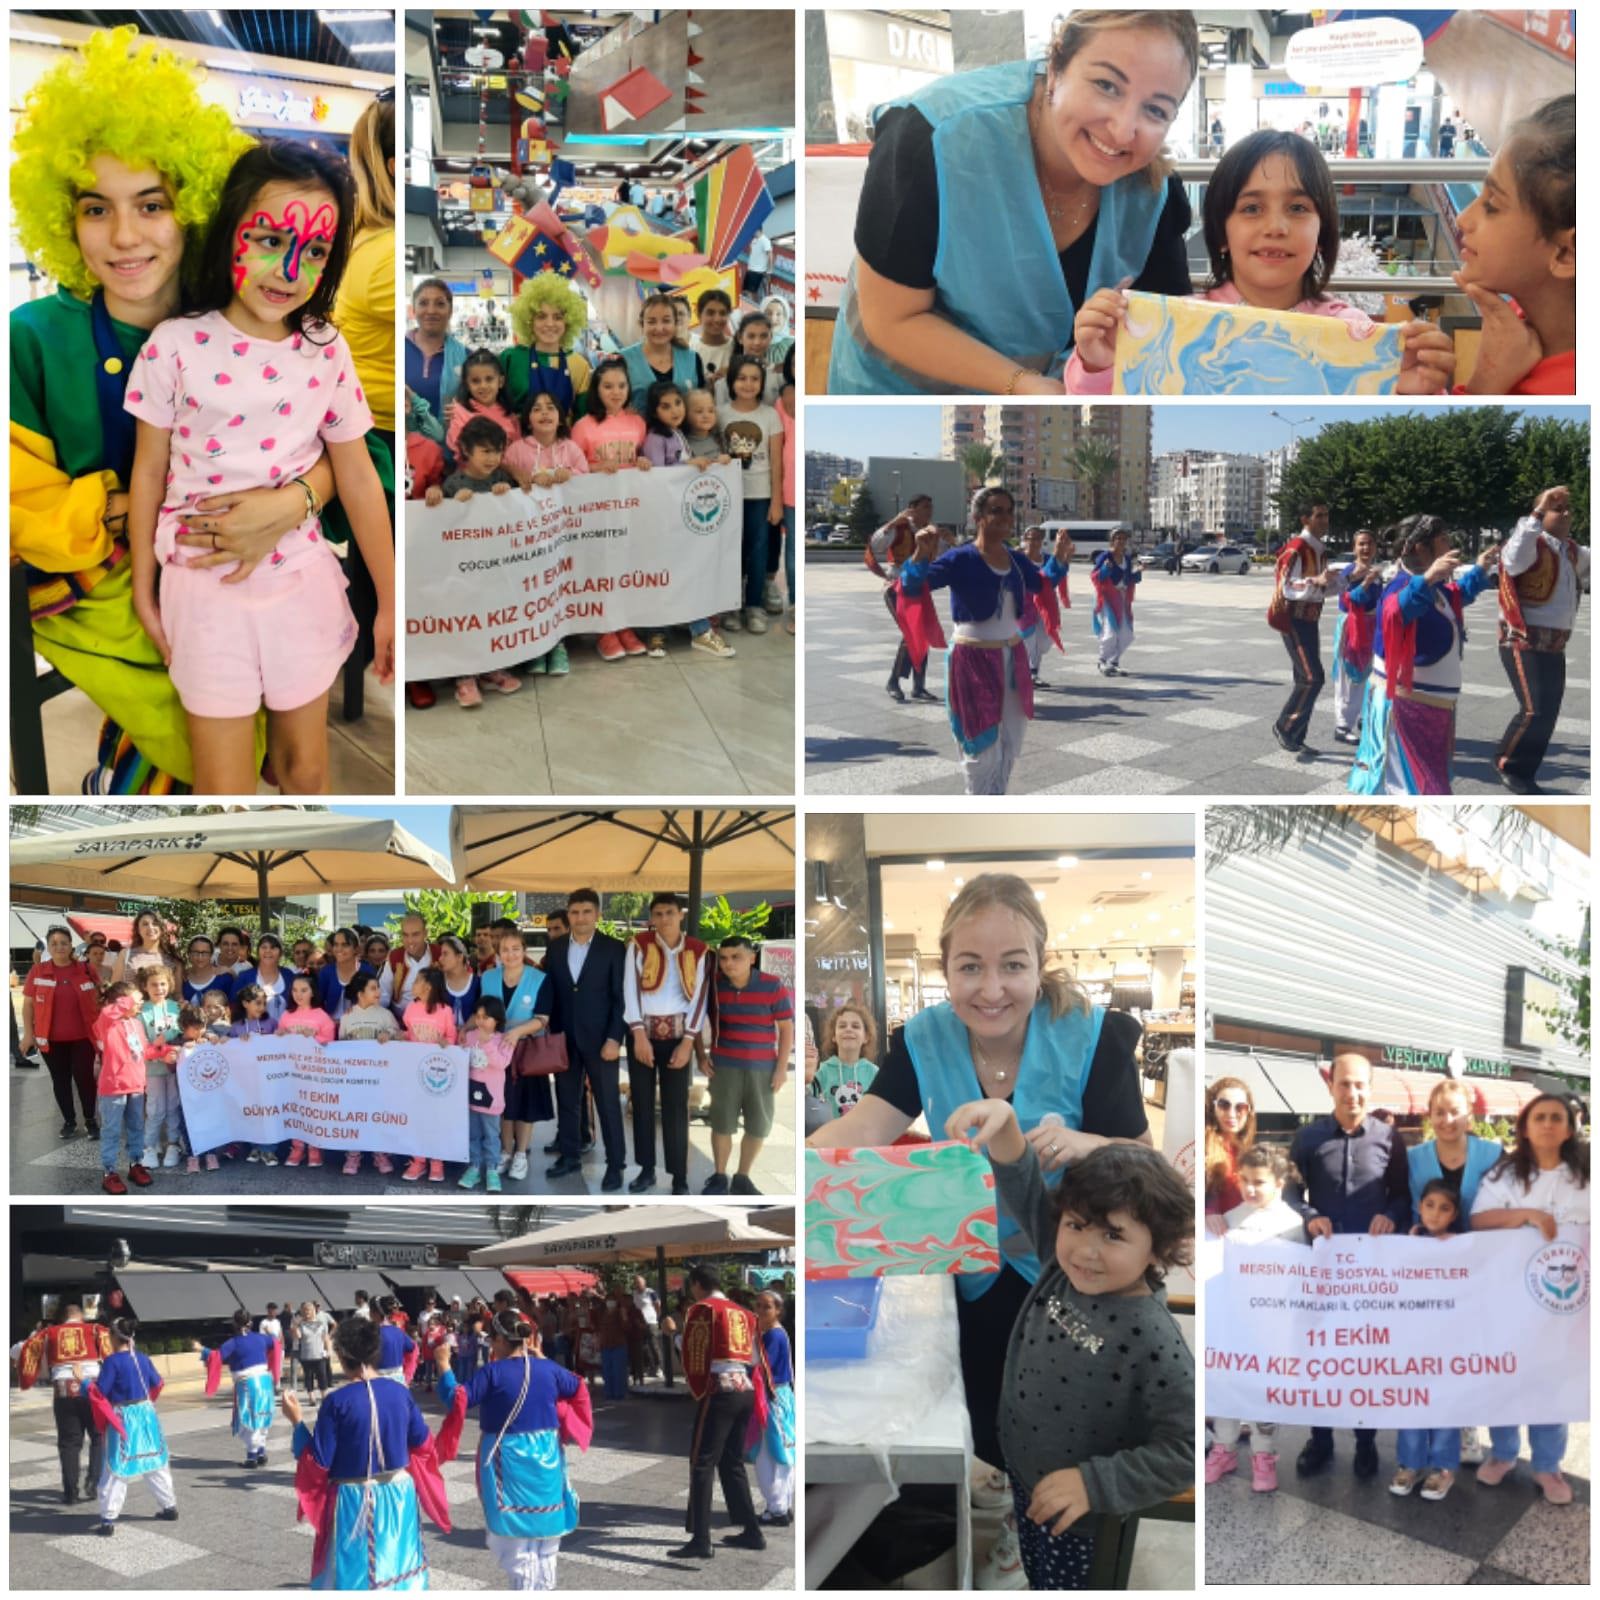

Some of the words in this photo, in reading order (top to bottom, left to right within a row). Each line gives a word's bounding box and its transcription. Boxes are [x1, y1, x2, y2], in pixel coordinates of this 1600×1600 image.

[442, 526, 493, 542] MERSİN
[522, 576, 539, 593] 11
[406, 615, 482, 635] DÜNYA
[487, 605, 518, 628] KIZ
[619, 569, 670, 590] GÜNÜ
[490, 620, 550, 653] KUTLU
[74, 836, 185, 854] SAYAPARK
[299, 1089, 308, 1100] 11
[310, 1091, 340, 1105] EKİM
[243, 1102, 280, 1117] DÜNYA
[300, 1106, 368, 1123] ÇOCUKLARI
[371, 1110, 408, 1126] GÜNÜ
[315, 1125, 359, 1139] OLSUN
[1240, 1261, 1285, 1275] MERSİN
[1288, 1262, 1318, 1278] AİLE
[1336, 1267, 1388, 1280] SOSYAL
[1391, 1266, 1469, 1280] HİZMETLER
[1302, 1280, 1313, 1294] İL
[1250, 1297, 1287, 1309] ÇOCUK
[1290, 1299, 1338, 1311] HAKLARI
[1353, 1299, 1395, 1312] ÇOCUK
[1399, 1298, 1455, 1311] KOMİTESİ
[1306, 1329, 1326, 1347] 11
[1335, 1323, 1391, 1346] EKİM
[1266, 1356, 1301, 1377] KIZ
[1306, 1354, 1443, 1382] ÇOCUKLARI
[1450, 1350, 1518, 1375] GÜNÜ
[1266, 1386, 1342, 1408] KUTLU
[1350, 1387, 1430, 1407] OLSUN
